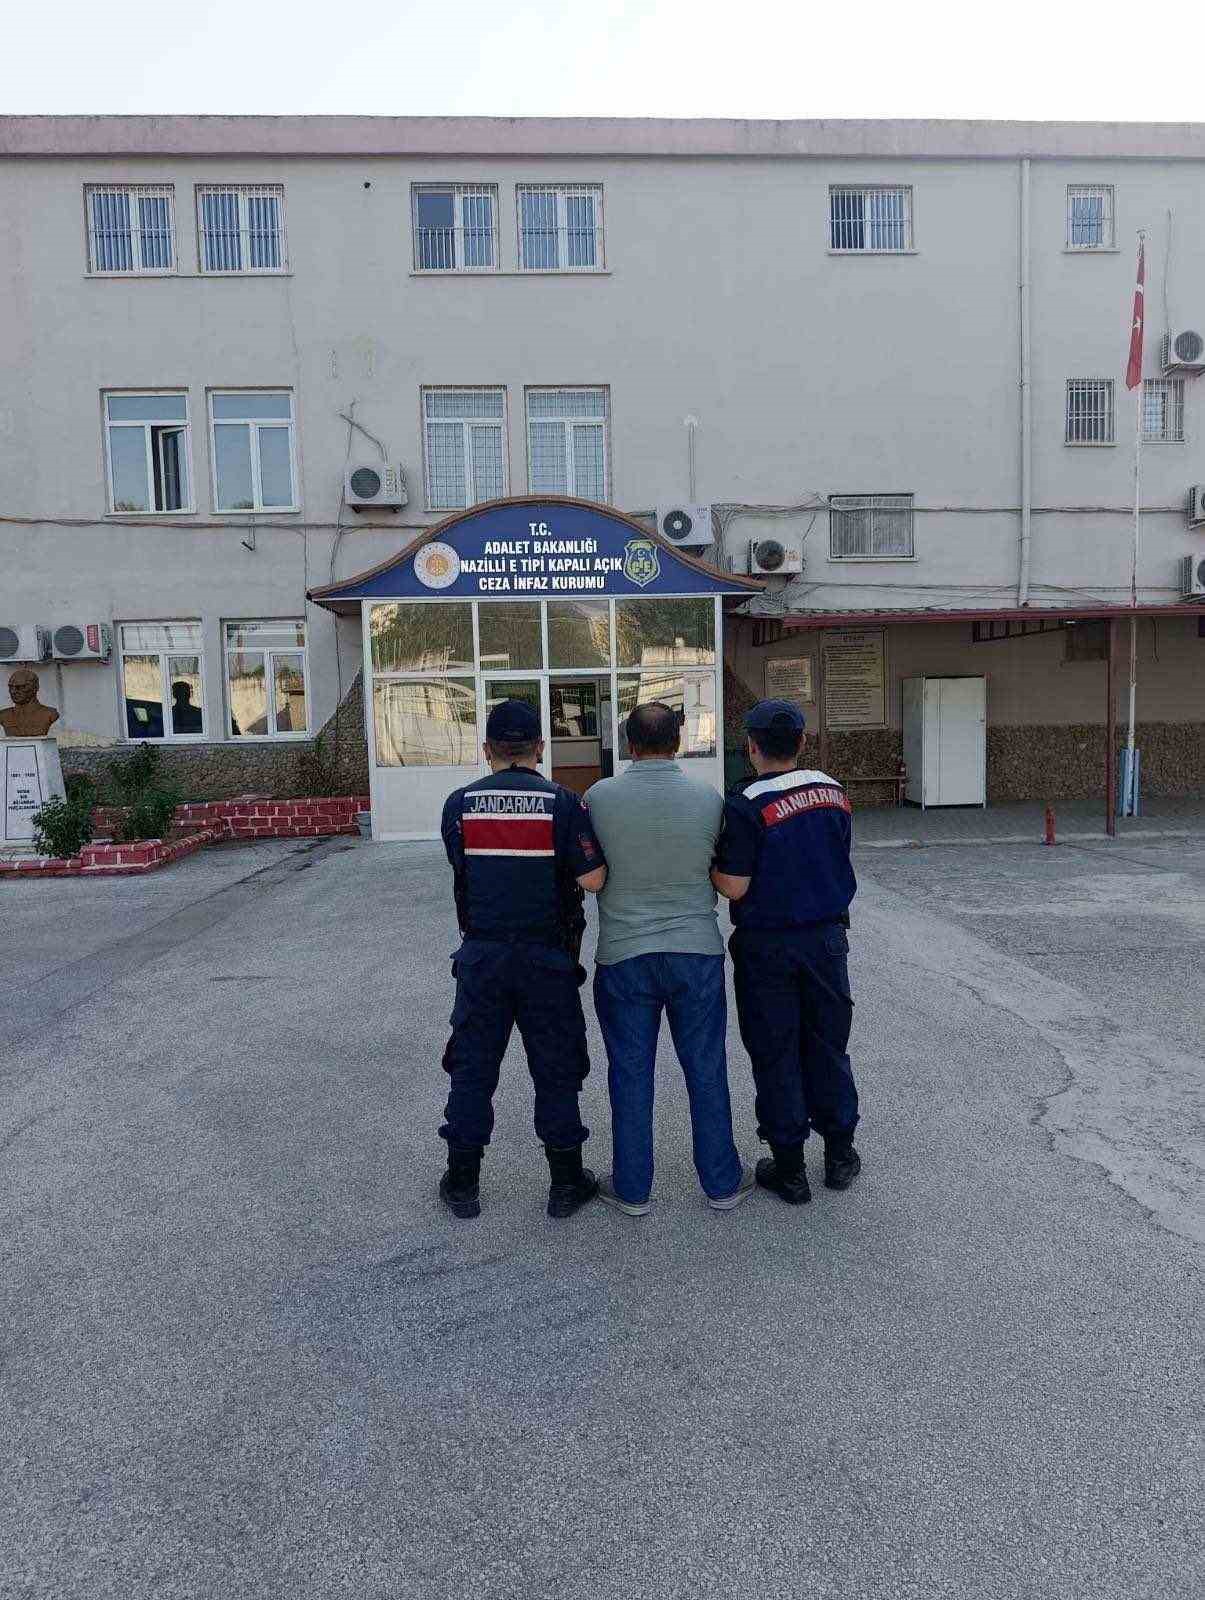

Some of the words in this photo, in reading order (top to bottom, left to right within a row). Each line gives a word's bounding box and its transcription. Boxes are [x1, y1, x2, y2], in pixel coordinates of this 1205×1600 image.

[529, 523, 552, 536] T.C.
[484, 541, 530, 554] ADALET
[533, 537, 597, 554] BAKANLIĞI
[460, 557, 506, 573] NAZİLLİ
[509, 560, 517, 572] E
[521, 556, 545, 572] TİPİ
[549, 558, 589, 572] KAPALI
[594, 558, 623, 575] AÇIK
[479, 577, 511, 590] CEZA
[513, 574, 548, 590] İNFAZ
[552, 576, 605, 590] KURUMU
[470, 796, 545, 813] JANDARMA
[775, 788, 846, 818] JANDARMA
